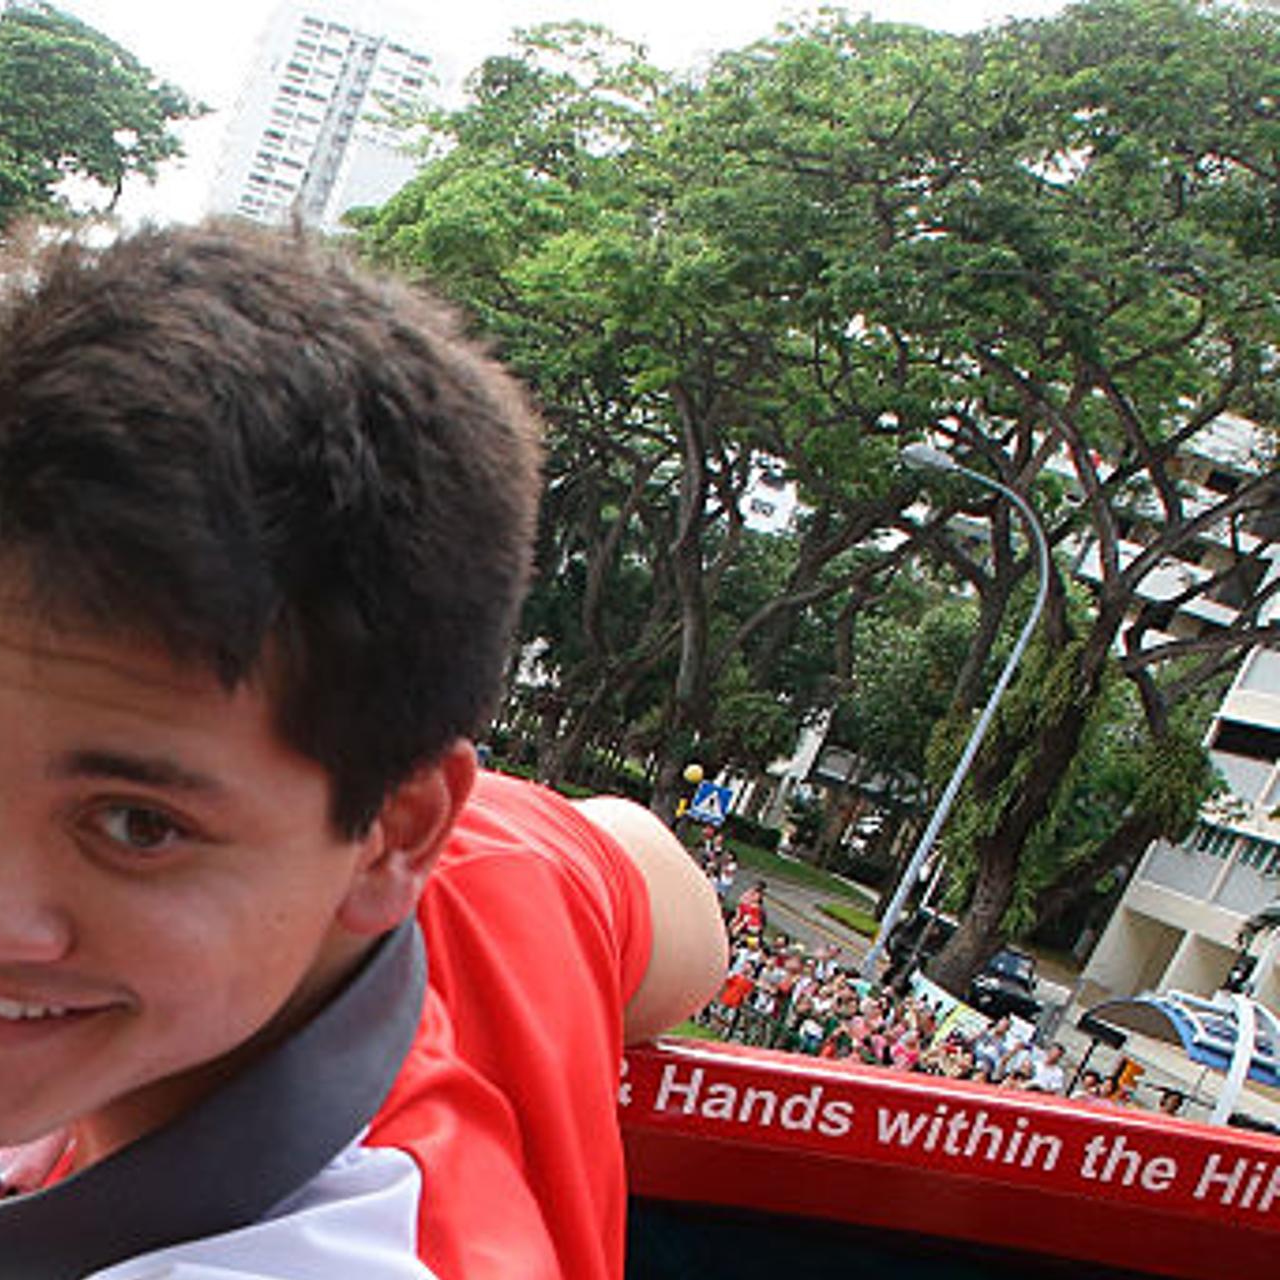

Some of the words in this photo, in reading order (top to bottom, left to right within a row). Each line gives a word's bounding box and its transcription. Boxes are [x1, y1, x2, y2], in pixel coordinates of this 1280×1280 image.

[653, 1063, 855, 1137] Hands
[877, 1103, 1063, 1172] within
[1080, 1134, 1177, 1191] the
